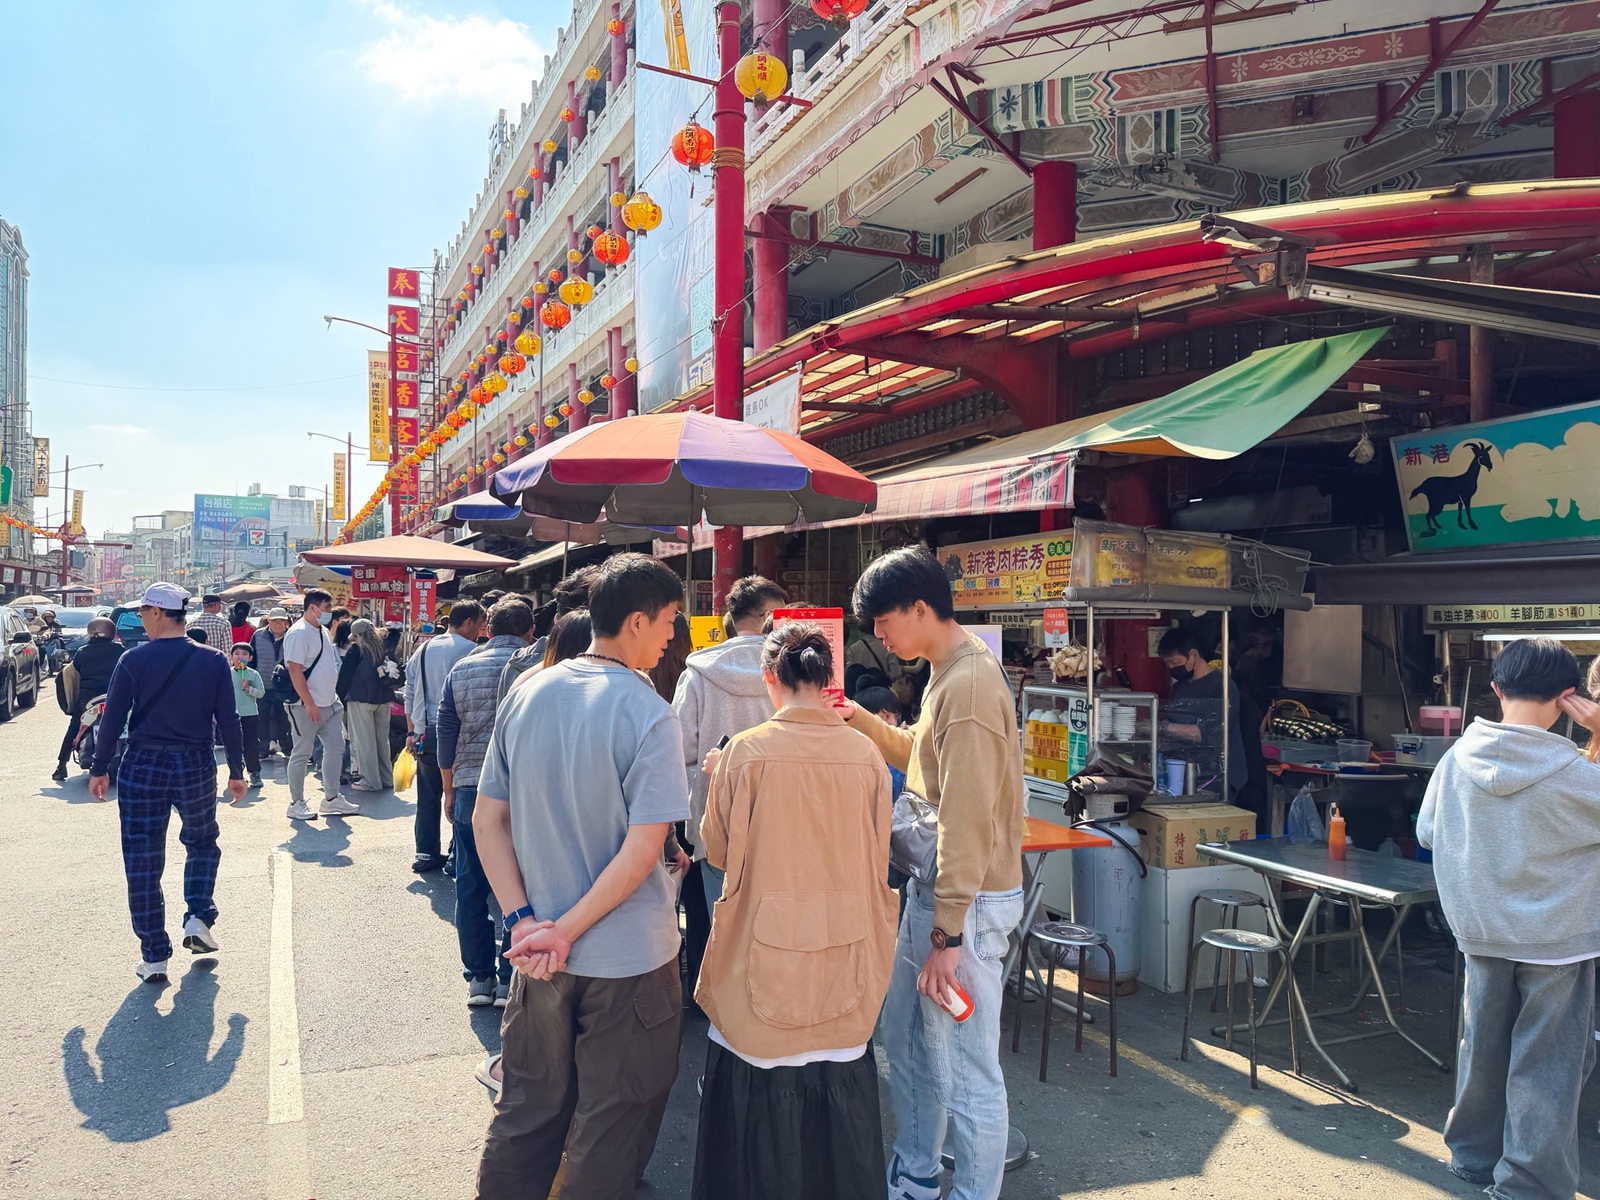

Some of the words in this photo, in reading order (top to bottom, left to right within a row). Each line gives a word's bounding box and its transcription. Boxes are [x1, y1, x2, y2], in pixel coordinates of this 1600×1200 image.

[1404, 443, 1450, 466] 新港
[966, 542, 1046, 576] 新港肉粽秀
[1174, 832, 1186, 865] 特選
